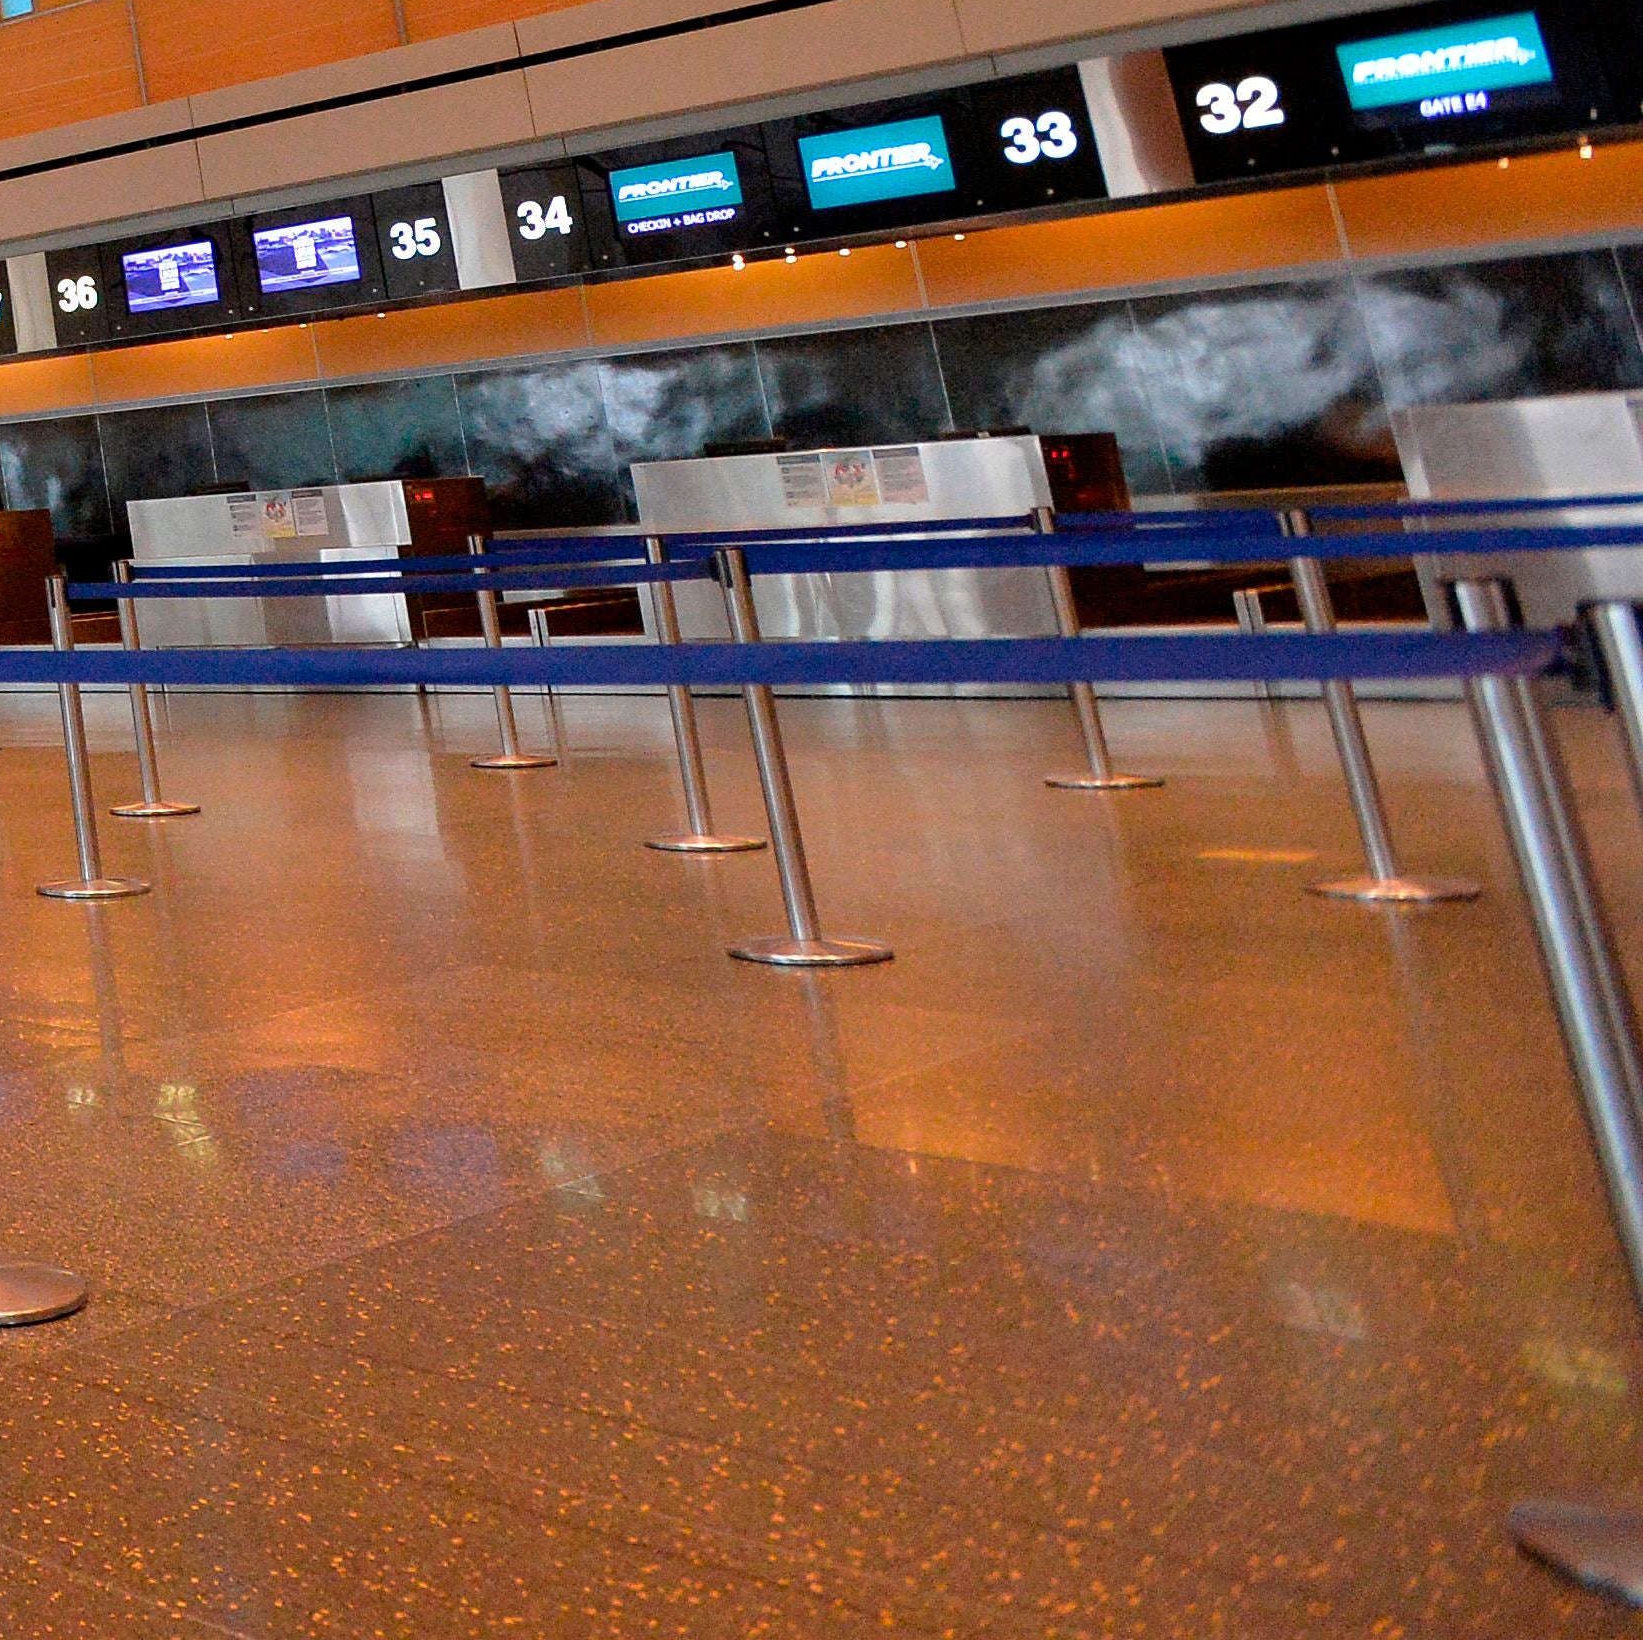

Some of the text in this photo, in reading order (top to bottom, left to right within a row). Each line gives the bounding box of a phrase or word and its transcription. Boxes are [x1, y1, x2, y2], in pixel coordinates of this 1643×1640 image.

[1352, 36, 1521, 84] FRONTIER
[1196, 76, 1285, 134] 32
[1000, 111, 1078, 164] 33
[811, 142, 932, 179] FRONTIER
[619, 171, 724, 201] FRONTIER
[390, 217, 441, 260] 35
[517, 195, 573, 240] 34
[627, 217, 671, 234] CHECKIN
[683, 211, 705, 226] BAG
[706, 208, 736, 223] DROP
[57, 275, 98, 313] 36
